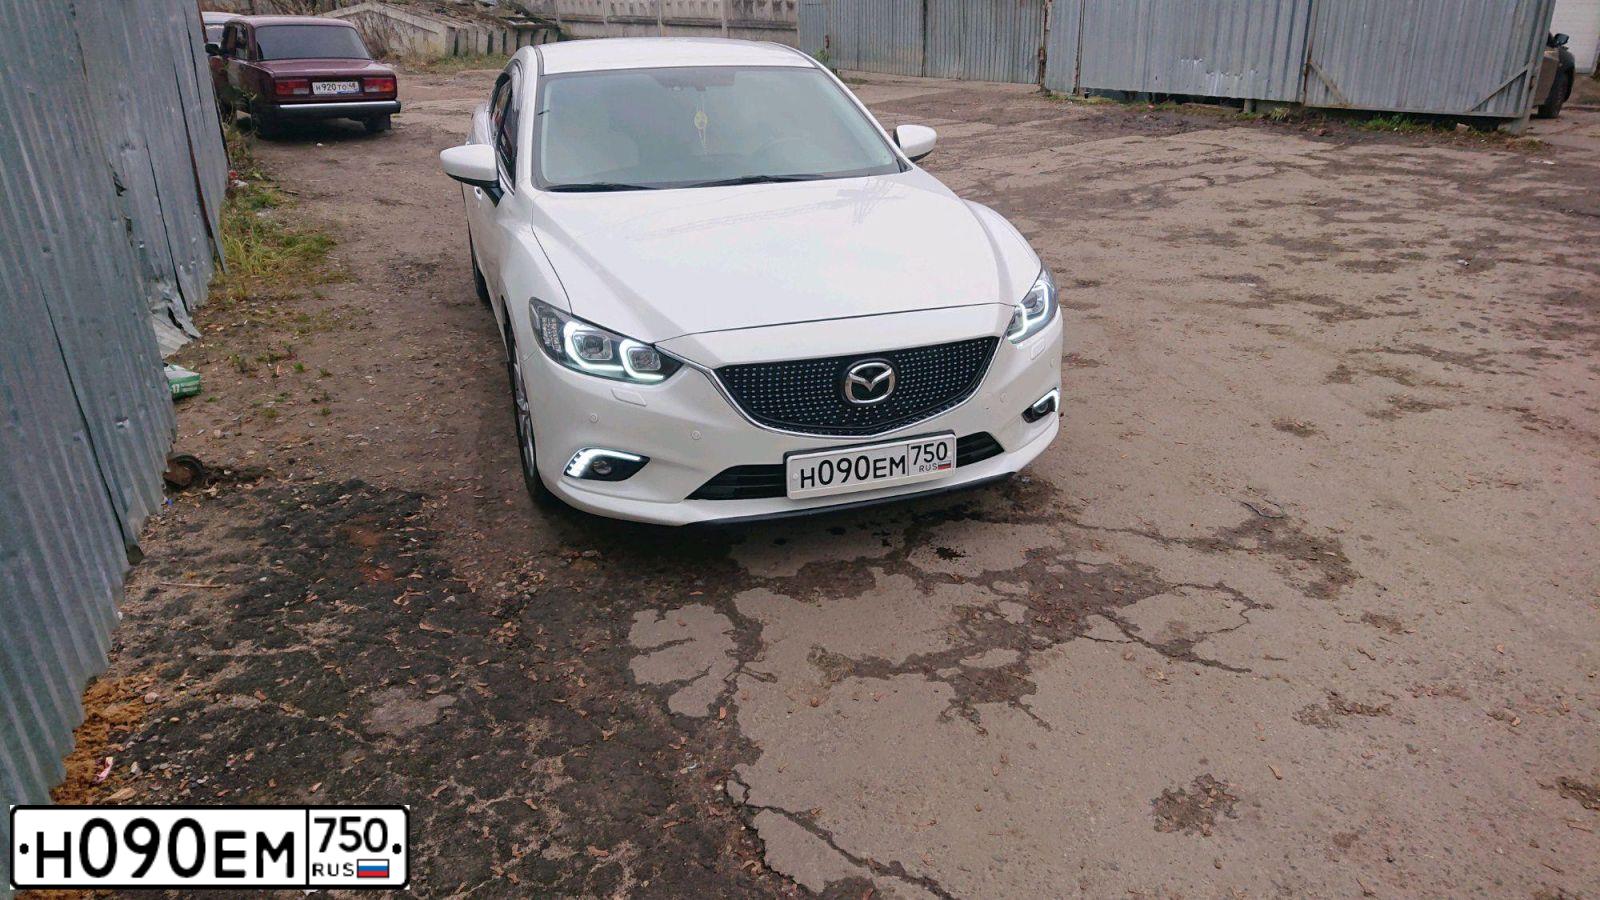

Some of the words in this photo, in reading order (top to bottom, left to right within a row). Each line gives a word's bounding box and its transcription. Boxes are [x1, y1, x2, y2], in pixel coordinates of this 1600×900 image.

[800, 455, 906, 488] H090EM
[911, 441, 948, 465] 750
[919, 463, 938, 473] RUS
